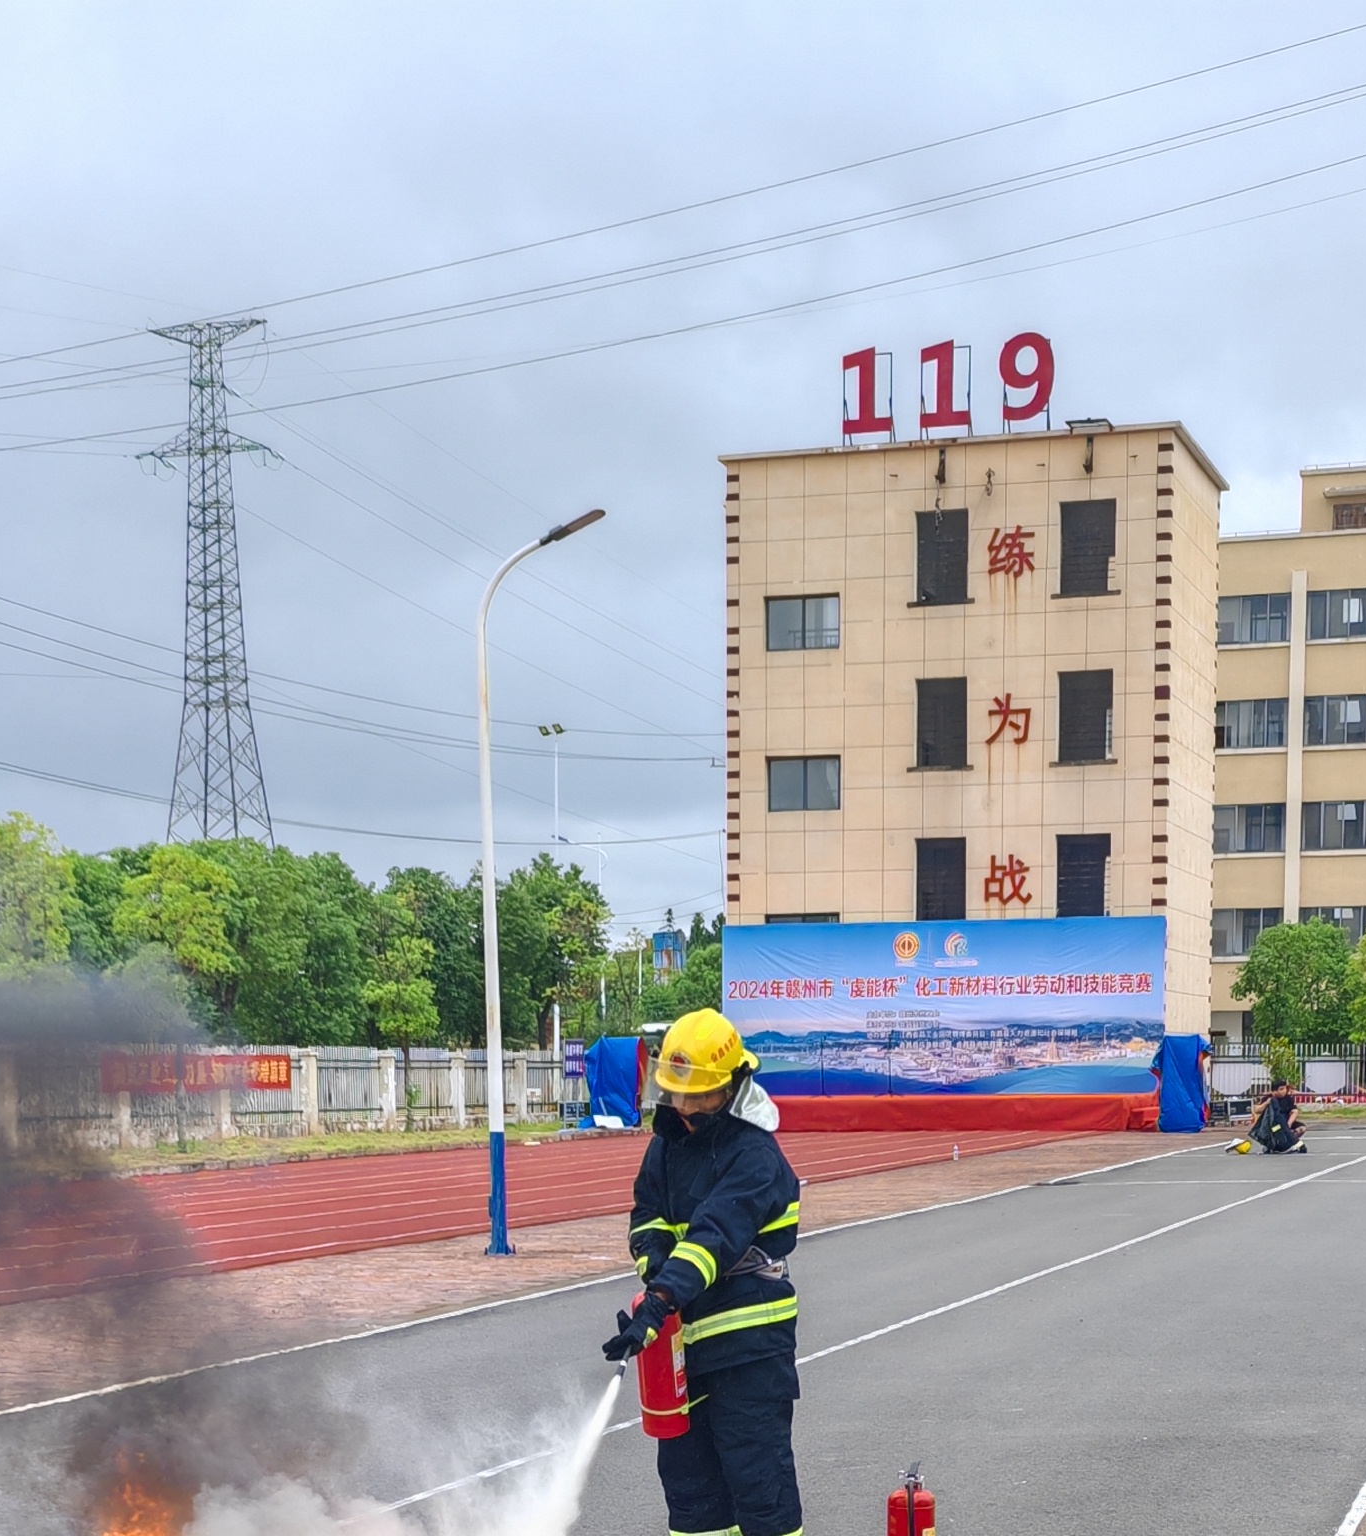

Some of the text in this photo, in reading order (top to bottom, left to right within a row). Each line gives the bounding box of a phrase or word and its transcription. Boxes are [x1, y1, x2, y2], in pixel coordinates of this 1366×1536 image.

[842, 331, 1055, 435] 119
[984, 524, 1035, 905] 练为战
